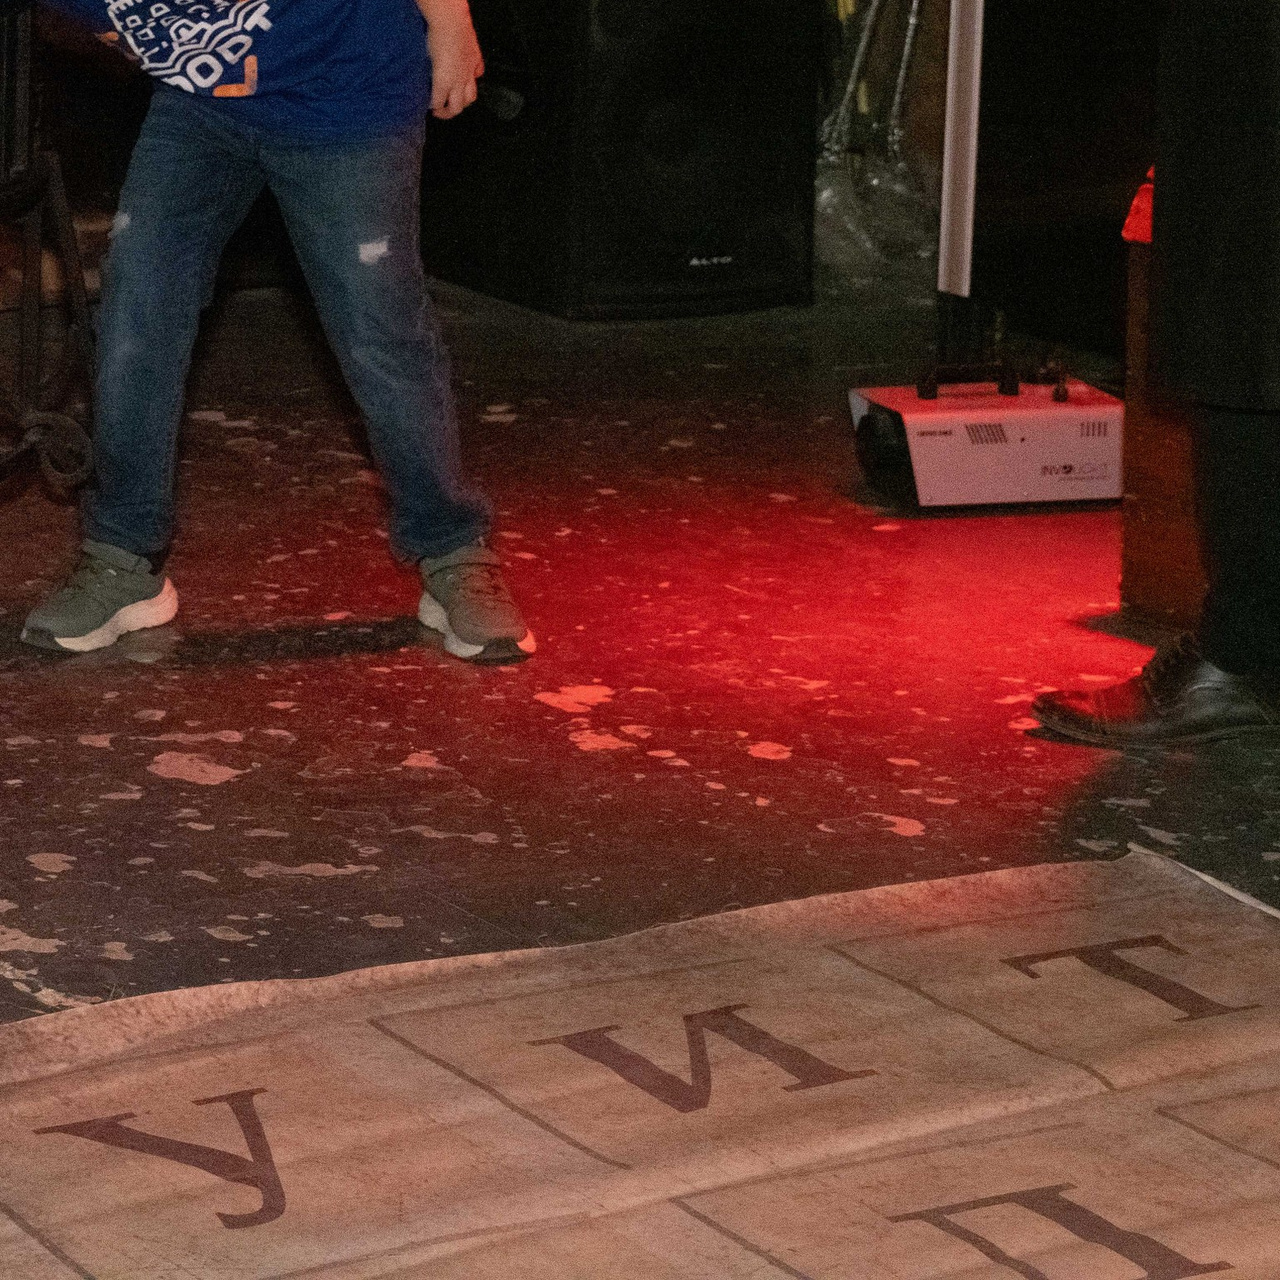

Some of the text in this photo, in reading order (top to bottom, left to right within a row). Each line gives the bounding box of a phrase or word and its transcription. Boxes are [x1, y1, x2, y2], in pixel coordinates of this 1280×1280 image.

[31, 1087, 287, 1229] У
[526, 1003, 880, 1113] И
[999, 934, 1263, 1023] Т
